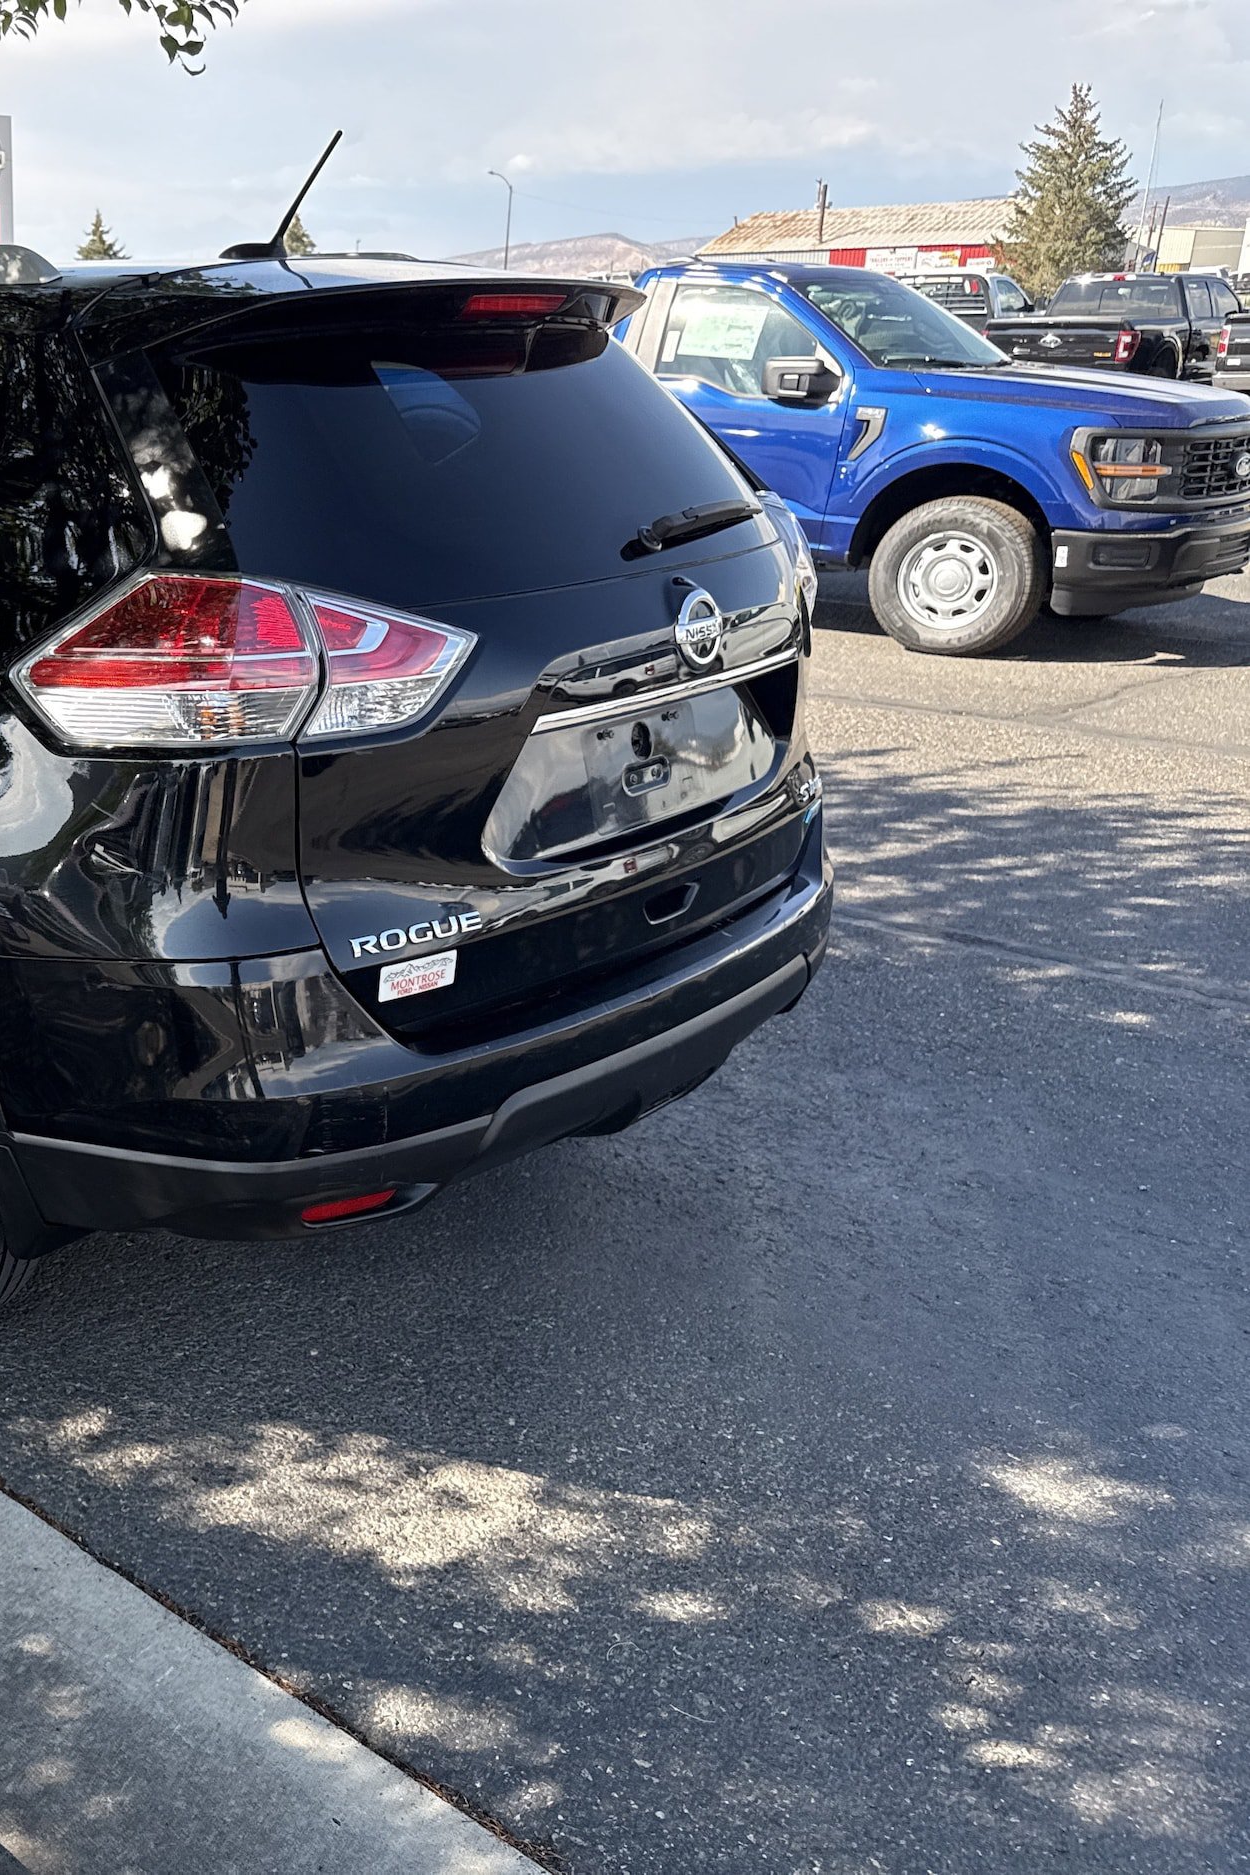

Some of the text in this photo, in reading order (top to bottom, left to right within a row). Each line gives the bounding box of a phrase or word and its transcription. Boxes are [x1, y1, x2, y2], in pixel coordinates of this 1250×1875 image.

[349, 911, 483, 958] ROGUE
[391, 968, 446, 992] MONTROSE
[397, 986, 413, 996] FORD
[419, 981, 438, 994] NISSAN
